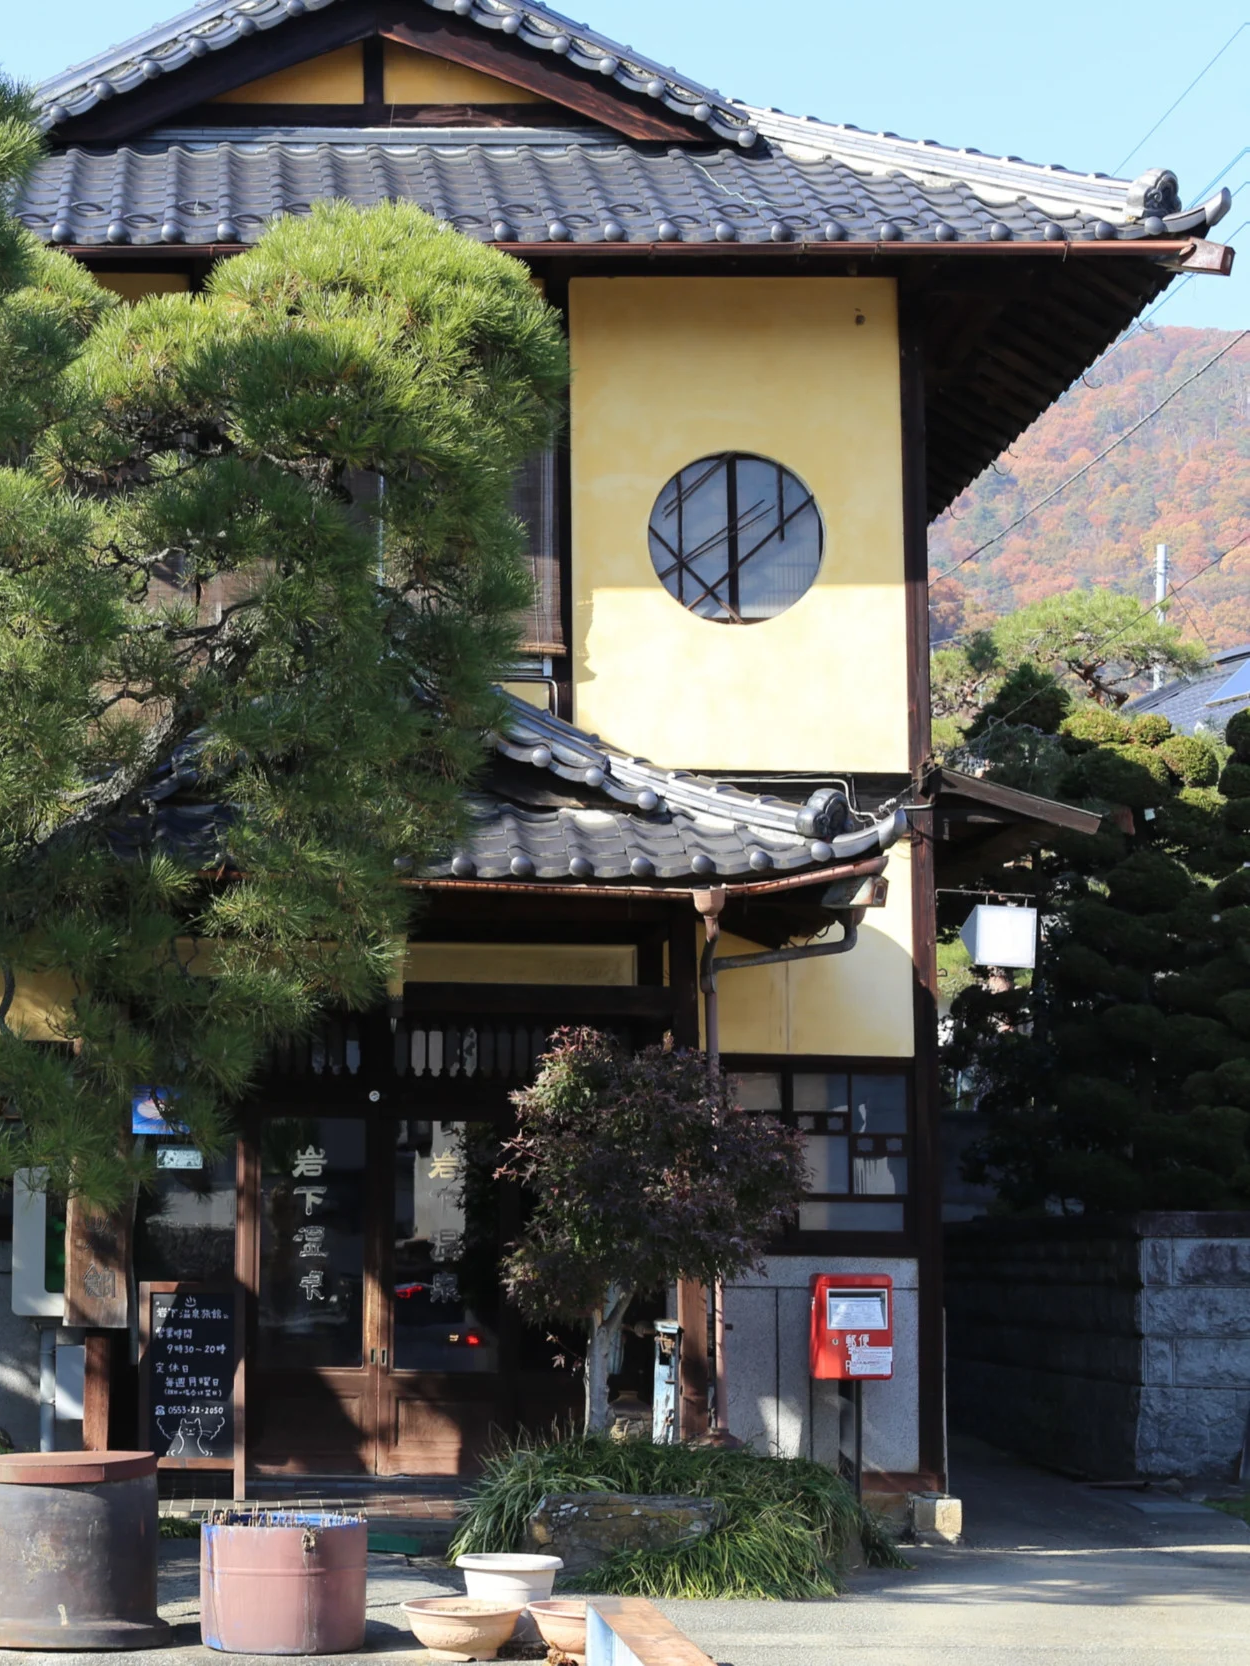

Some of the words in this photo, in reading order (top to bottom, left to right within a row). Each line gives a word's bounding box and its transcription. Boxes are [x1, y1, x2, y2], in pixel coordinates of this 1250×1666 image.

[155, 1326, 193, 1340] 営業時間
[155, 1362, 189, 1374] 定休日
[165, 1376, 220, 1388] 毎週月曜日
